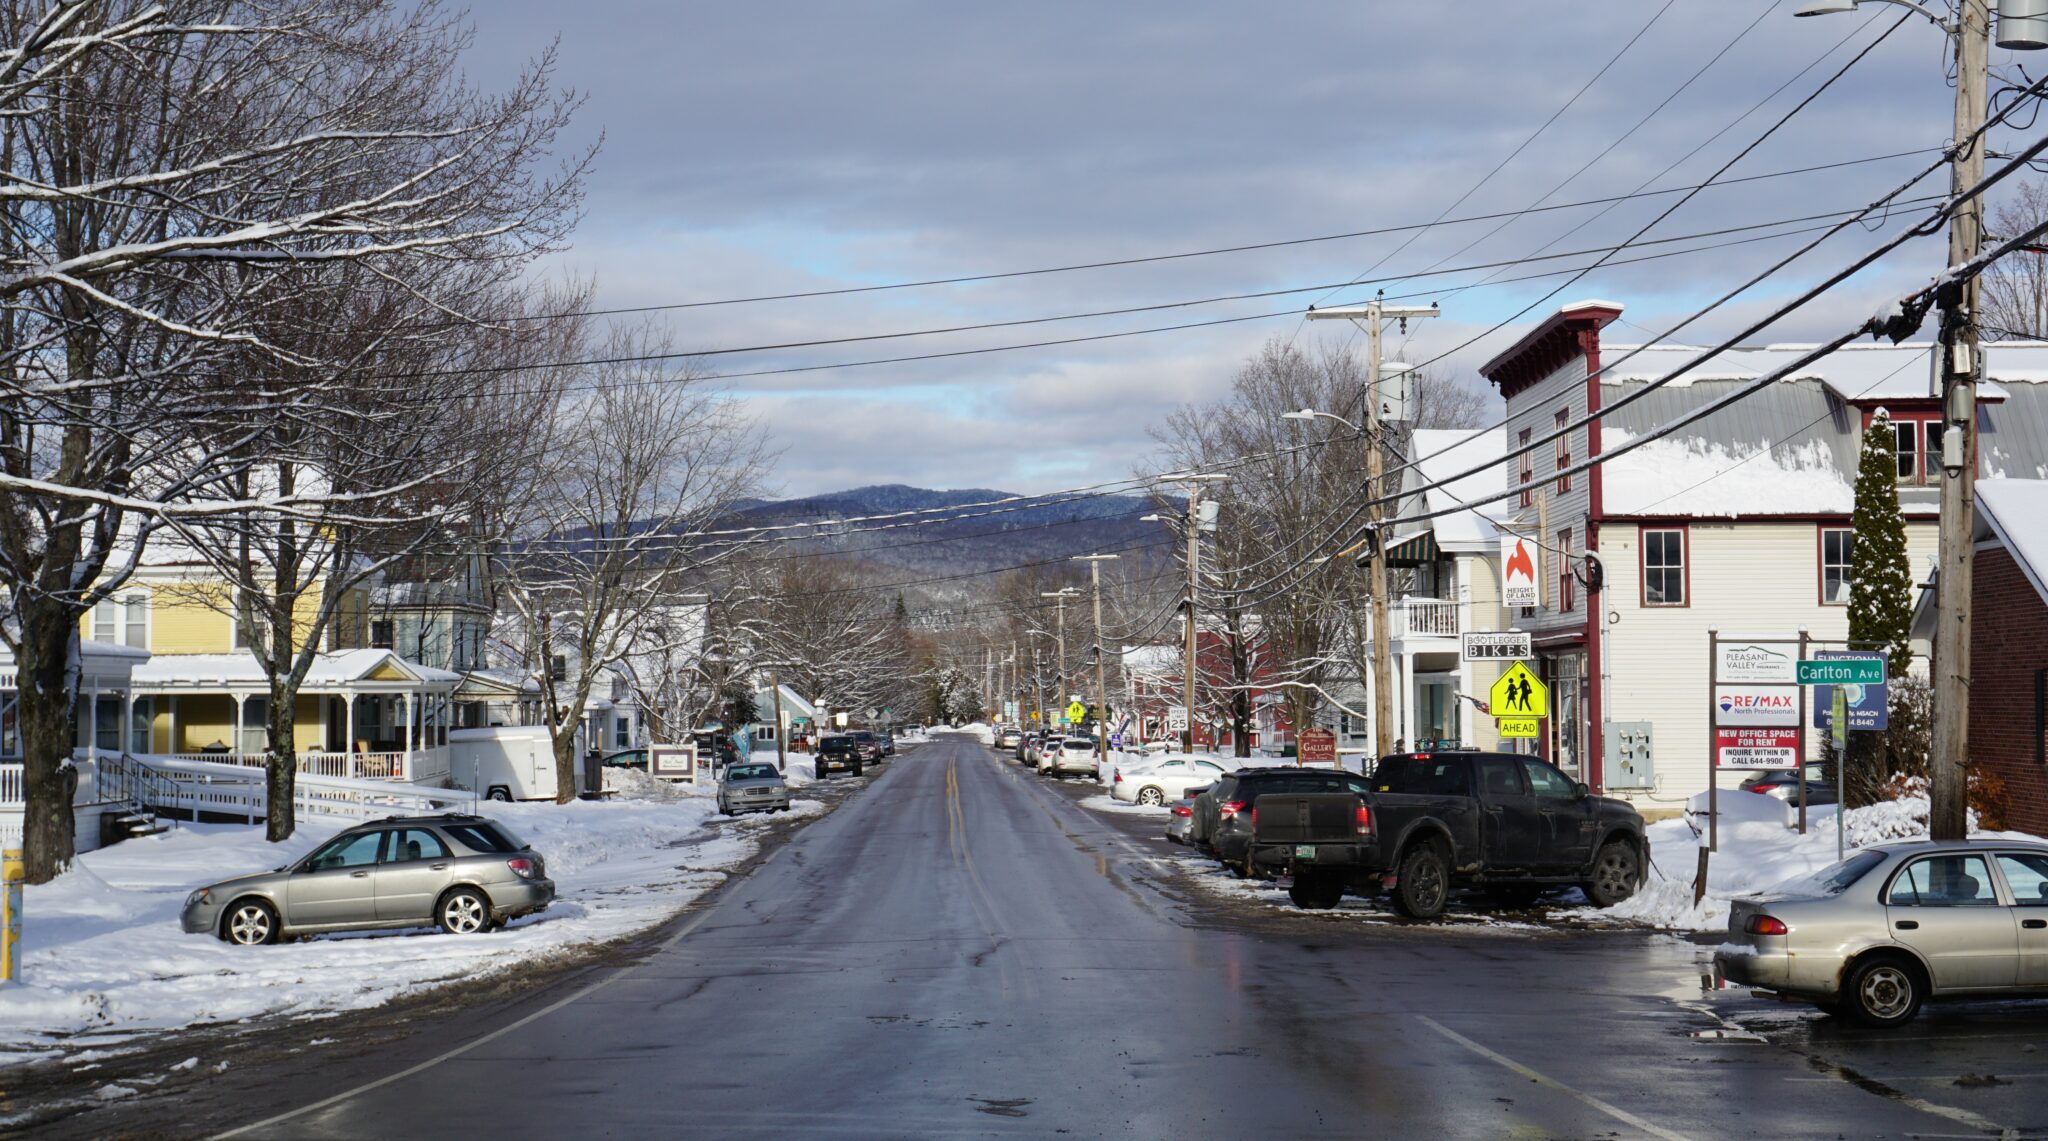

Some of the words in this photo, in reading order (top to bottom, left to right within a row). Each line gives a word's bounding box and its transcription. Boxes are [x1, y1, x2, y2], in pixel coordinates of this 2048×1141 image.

[1467, 636, 1528, 644] BOOTLEGGER
[1469, 645, 1527, 656] BIKES
[1726, 653, 1768, 661] PLEASANT
[1800, 666, 1852, 679] Carlton
[1859, 669, 1880, 678] Ave
[1734, 695, 1792, 707] RE/MAX
[1171, 719, 1186, 728] 25
[1503, 723, 1535, 732] AHEAD
[1719, 729, 1737, 738] NEW
[1739, 729, 1767, 738] OFFICE
[1769, 729, 1796, 738] SPACE
[1738, 738, 1754, 746] FOR
[1756, 738, 1777, 746] RENT
